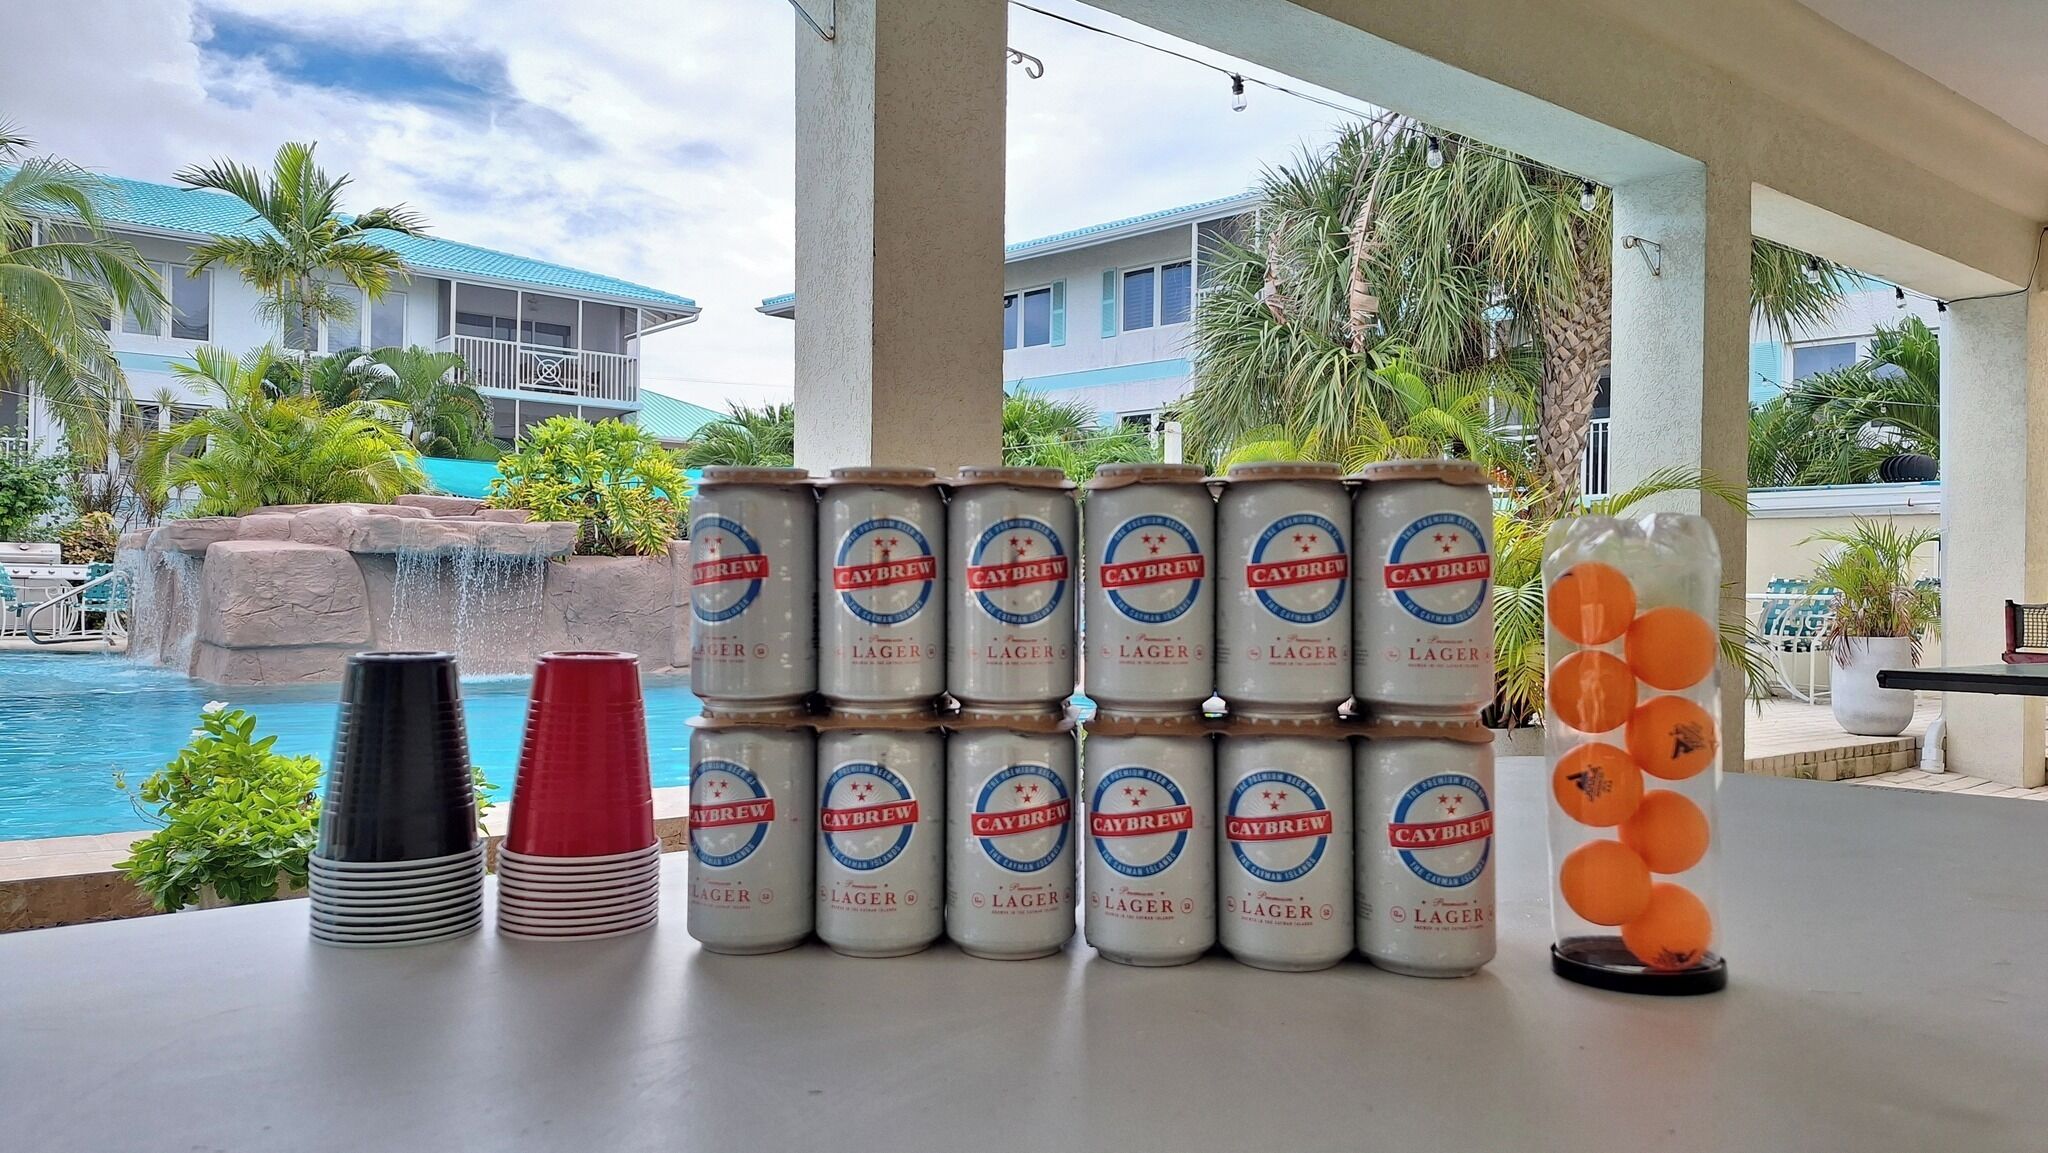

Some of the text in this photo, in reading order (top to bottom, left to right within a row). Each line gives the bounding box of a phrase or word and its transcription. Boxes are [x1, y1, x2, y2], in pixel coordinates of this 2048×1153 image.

[838, 561, 933, 584] CAYBREW
[972, 562, 1065, 585] CAYBREW
[1105, 559, 1199, 584] CAYBREW
[1252, 559, 1346, 582] CAYBREW
[1391, 559, 1488, 584] CAYBREW
[853, 646, 920, 658] LAGER
[988, 646, 1054, 658] LAGER
[1120, 645, 1189, 657] LAGER
[1270, 646, 1337, 658] LAGER
[1409, 647, 1479, 660] LAGER
[823, 805, 912, 826] CAYBREW
[976, 805, 1067, 831] CAYBREW
[1093, 811, 1187, 831] CAYBREW
[1229, 815, 1326, 835] CAYBREW
[1395, 817, 1490, 842] CAYBREW
[832, 890, 896, 904] LAGER
[993, 891, 1058, 907] LAGER
[1105, 896, 1174, 913] LAGER
[1242, 901, 1312, 918] LAGER
[1415, 909, 1483, 924] LAGER
